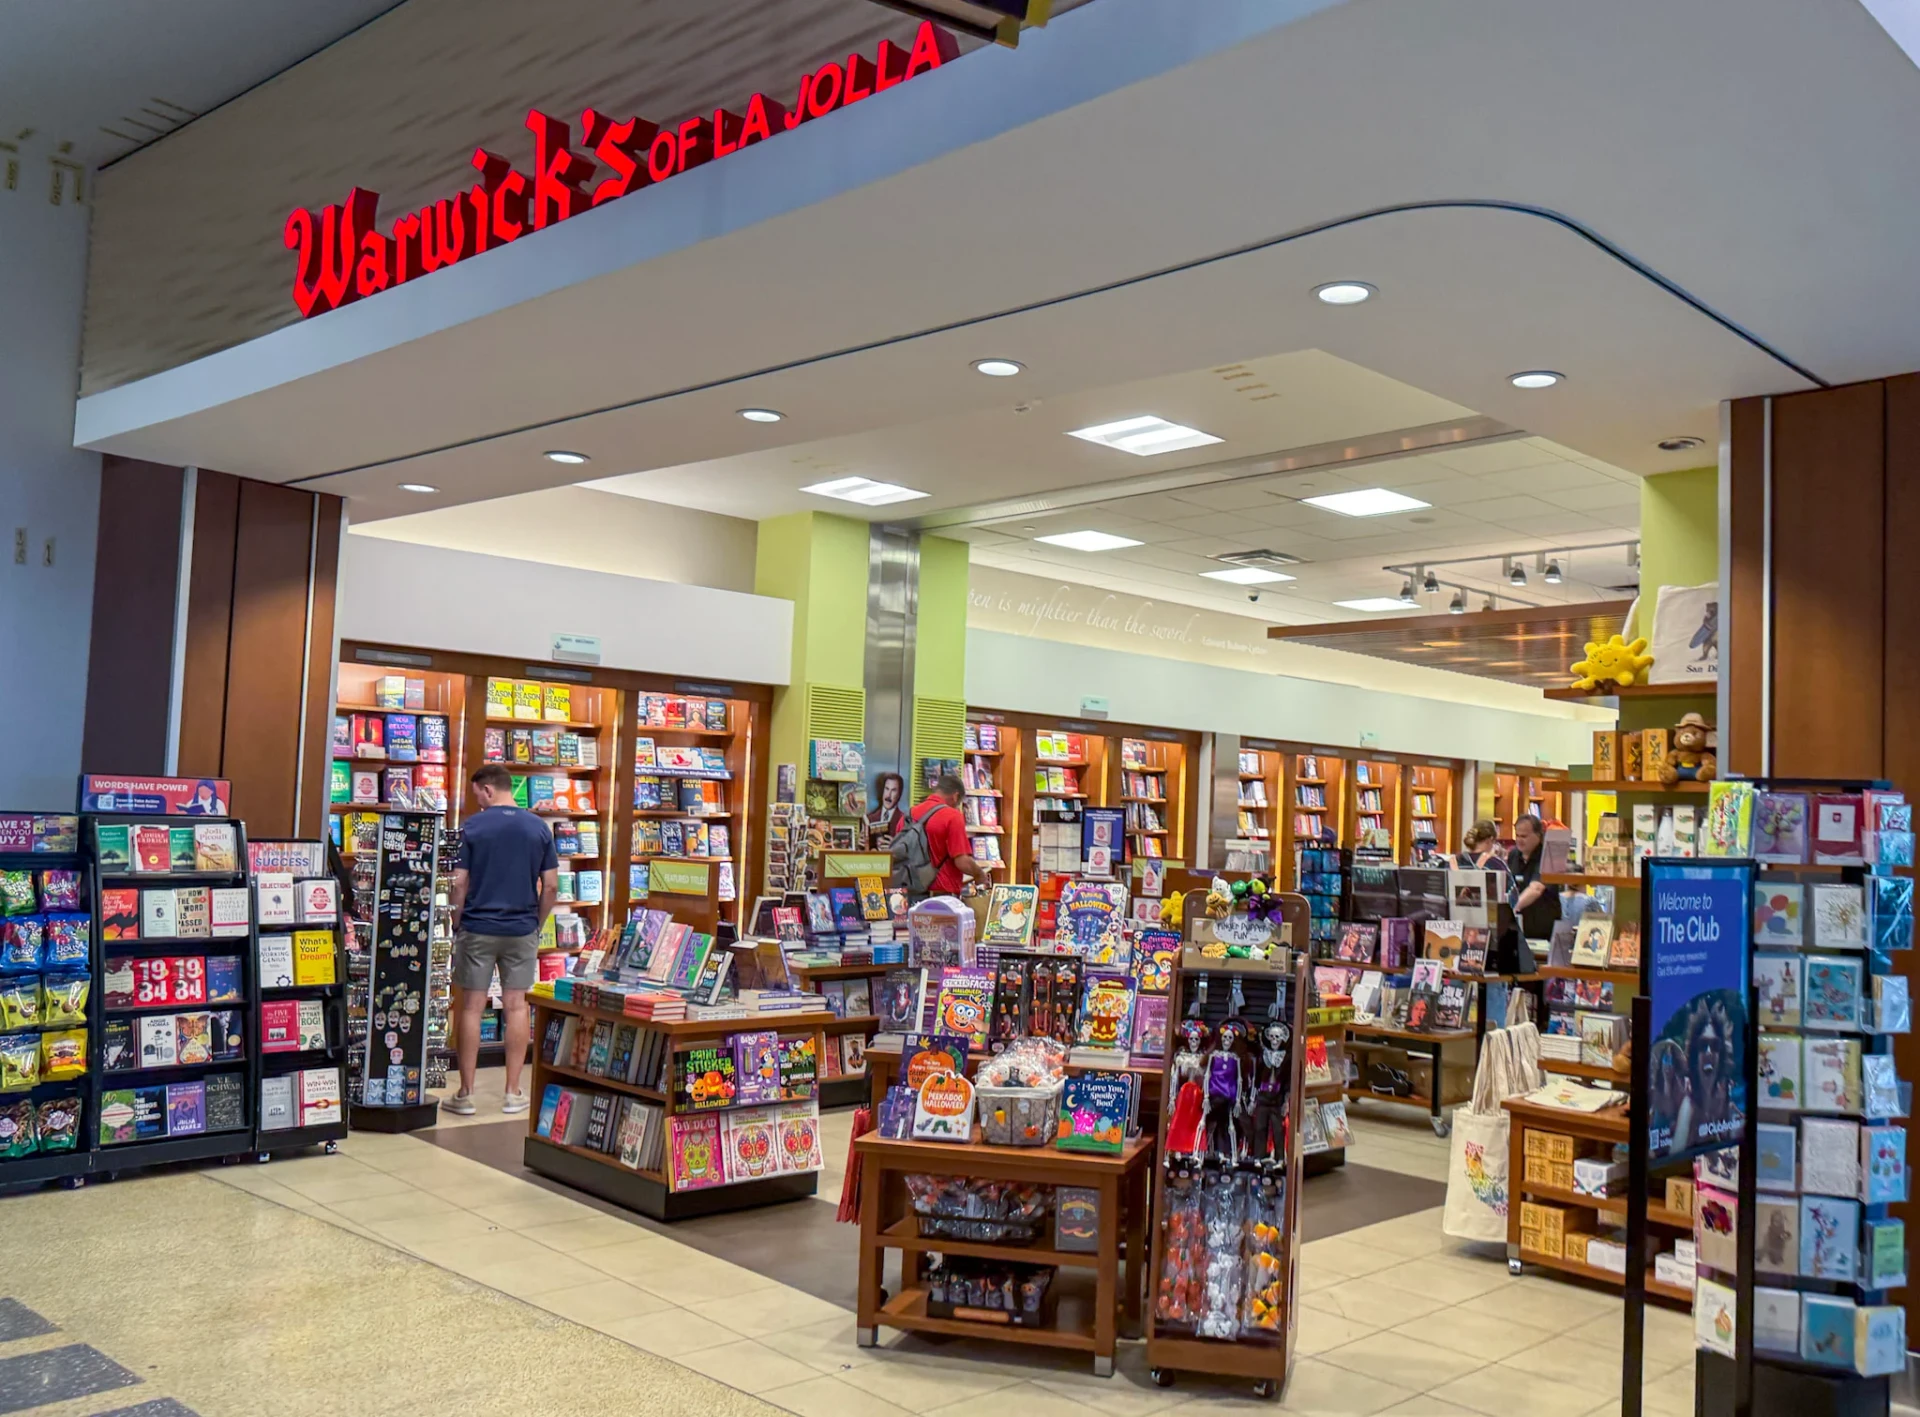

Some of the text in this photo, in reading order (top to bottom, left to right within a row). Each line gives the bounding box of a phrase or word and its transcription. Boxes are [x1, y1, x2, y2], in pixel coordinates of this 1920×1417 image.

[283, 20, 944, 318] Warwick's OF LA JOLLA
[997, 592, 1012, 611] is
[1017, 585, 1083, 636] mightier
[1086, 594, 1121, 630] than
[1124, 602, 1153, 635] the
[1686, 665, 1703, 673] San
[94, 780, 188, 792] WORDS HAVE POWER
[0, 835, 27, 845] UY 2
[255, 858, 310, 867] SUCCESS
[664, 873, 690, 884] FEATURED
[1658, 892, 1713, 911] Welcome to
[1069, 901, 1113, 913] HALLOWEEN
[1658, 915, 1720, 944] The Club
[300, 953, 332, 961] Dream?
[943, 979, 996, 988] STICKER FACES
[301, 1017, 321, 1025] ROG!
[690, 1048, 718, 1060] PAINT
[686, 1057, 732, 1073] STICKER
[206, 1083, 241, 1092] SCHWAB
[306, 1079, 337, 1088] WIN-WIN
[1087, 1084, 1107, 1093] Love
[928, 1092, 964, 1101] PEEKABOO
[1089, 1091, 1117, 1101] Spooky
[695, 1099, 730, 1110] HALLOWEEN
[924, 1100, 965, 1109] HALLOWEEN
[1096, 1099, 1114, 1107] Boo!
[172, 1123, 202, 1132] ALVAREZ
